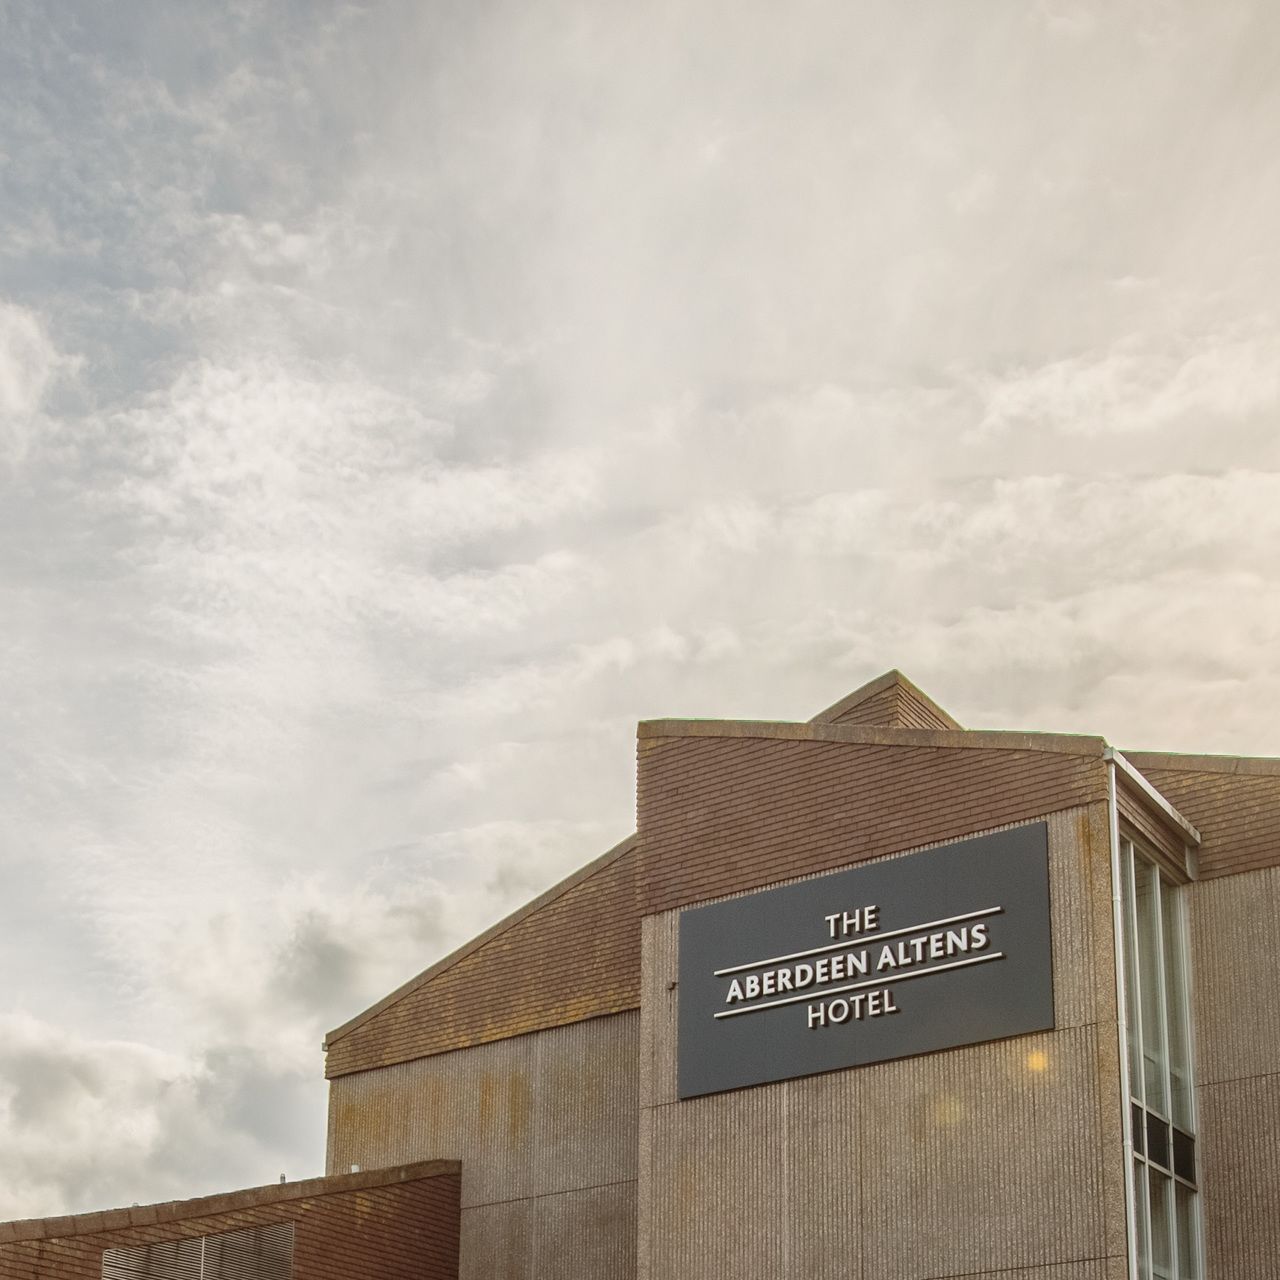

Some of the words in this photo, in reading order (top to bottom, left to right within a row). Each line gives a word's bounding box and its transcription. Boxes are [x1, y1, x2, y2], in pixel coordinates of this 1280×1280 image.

[824, 904, 879, 939] THE
[725, 949, 868, 1004] ABERDEEN
[875, 922, 989, 971] ALTENS
[807, 989, 898, 1029] HOTEL
